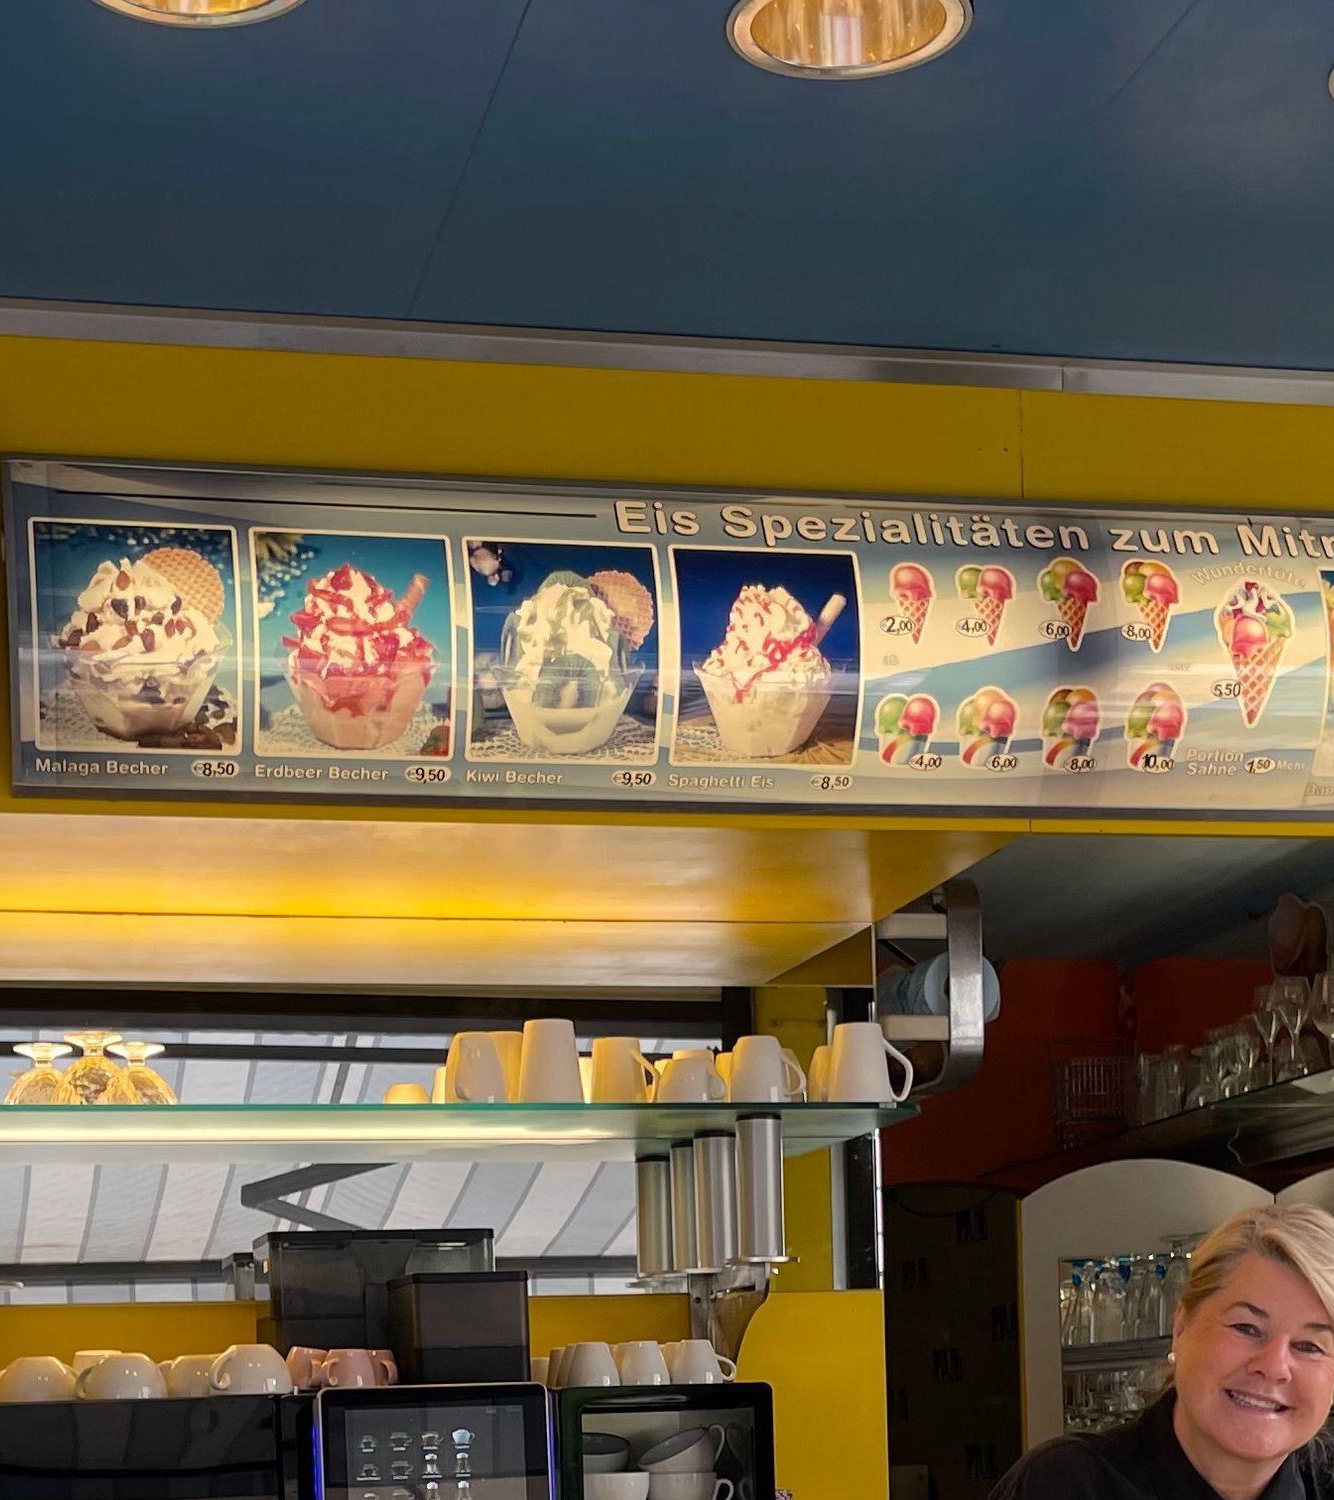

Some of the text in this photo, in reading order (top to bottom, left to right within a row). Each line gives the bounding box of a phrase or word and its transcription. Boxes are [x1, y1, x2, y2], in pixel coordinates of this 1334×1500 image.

[615, 500, 701, 537] Eis
[720, 504, 1091, 552] Spezialitäten
[1108, 525, 1220, 557] zum
[1185, 748, 1245, 765] Portion
[35, 757, 101, 778] Malaga
[105, 759, 169, 776] Becher
[254, 763, 323, 781] Erdbeer
[328, 765, 389, 782] Becher
[1185, 761, 1238, 777] Sahne
[466, 769, 501, 785] Kiwi
[504, 770, 564, 786] Becher
[668, 773, 746, 792] Spaghetti
[751, 775, 775, 789] Eis
